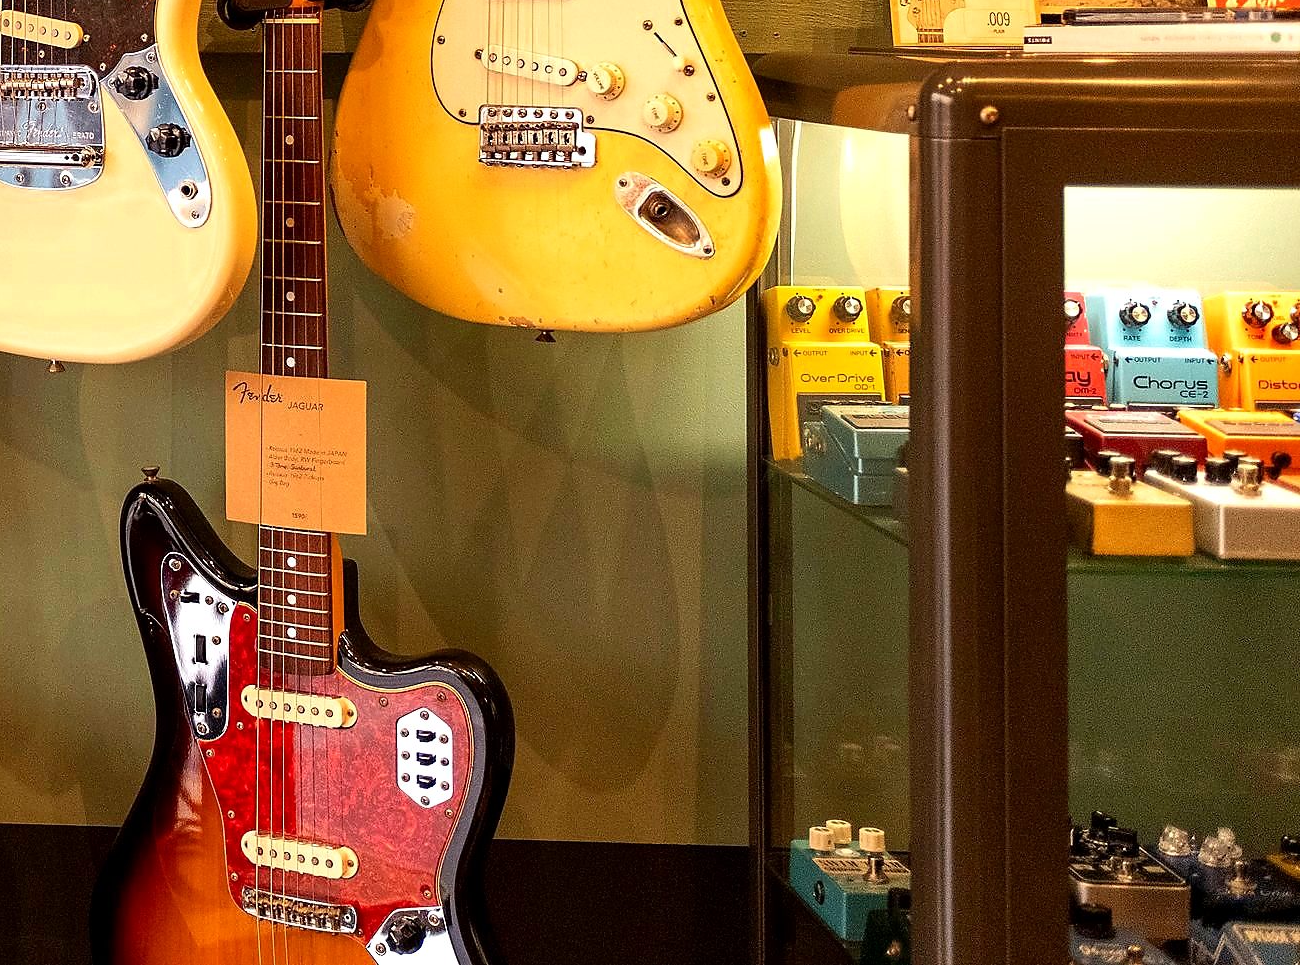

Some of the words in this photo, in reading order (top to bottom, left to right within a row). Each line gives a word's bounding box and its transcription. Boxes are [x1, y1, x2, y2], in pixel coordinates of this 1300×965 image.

[987, 12, 1011, 26] .009
[1133, 376, 1208, 389] Chorus
[1258, 380, 1300, 390] Disto
[233, 381, 284, 404] Fender
[287, 401, 324, 411] JAGUAR
[1074, 387, 1097, 395] DM-2
